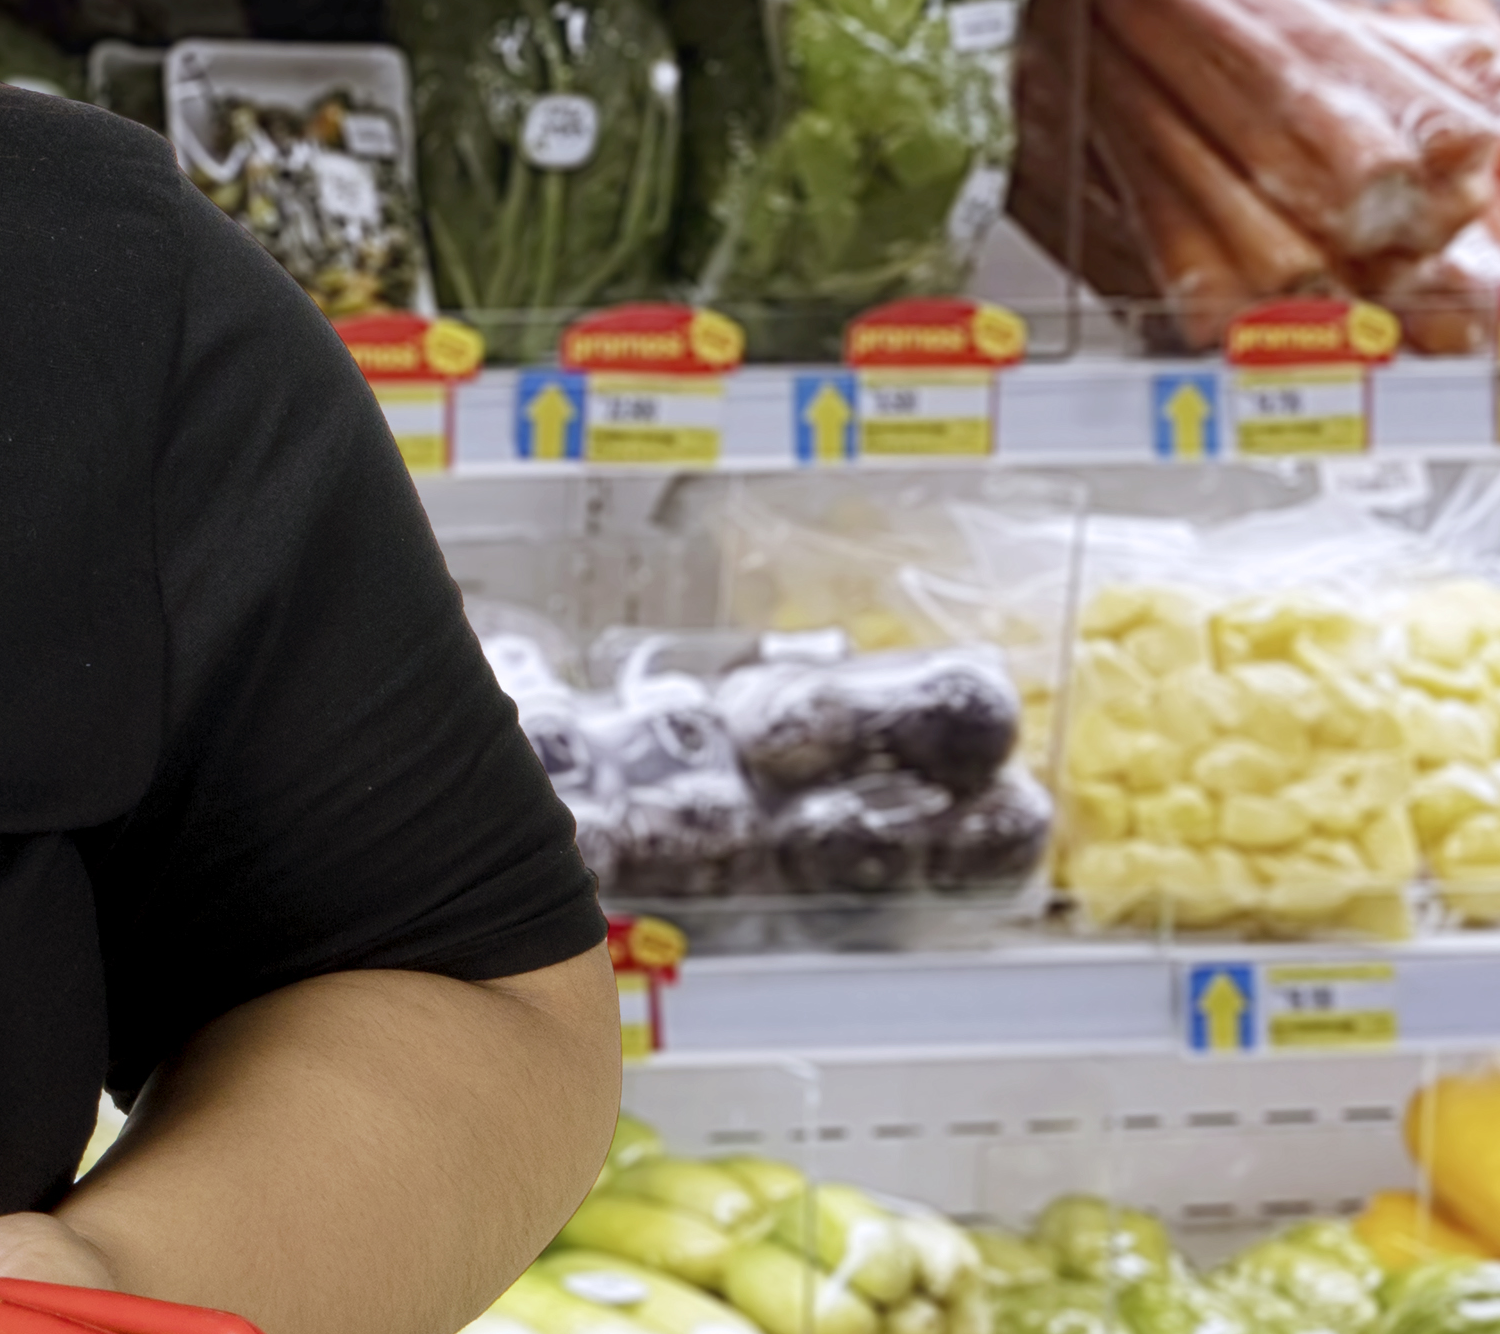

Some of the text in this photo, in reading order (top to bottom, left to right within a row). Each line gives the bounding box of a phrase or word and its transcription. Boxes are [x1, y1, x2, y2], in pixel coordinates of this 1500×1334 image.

[569, 331, 683, 363] promosi
[851, 323, 966, 355] promosi
[1230, 323, 1345, 355] promosi
